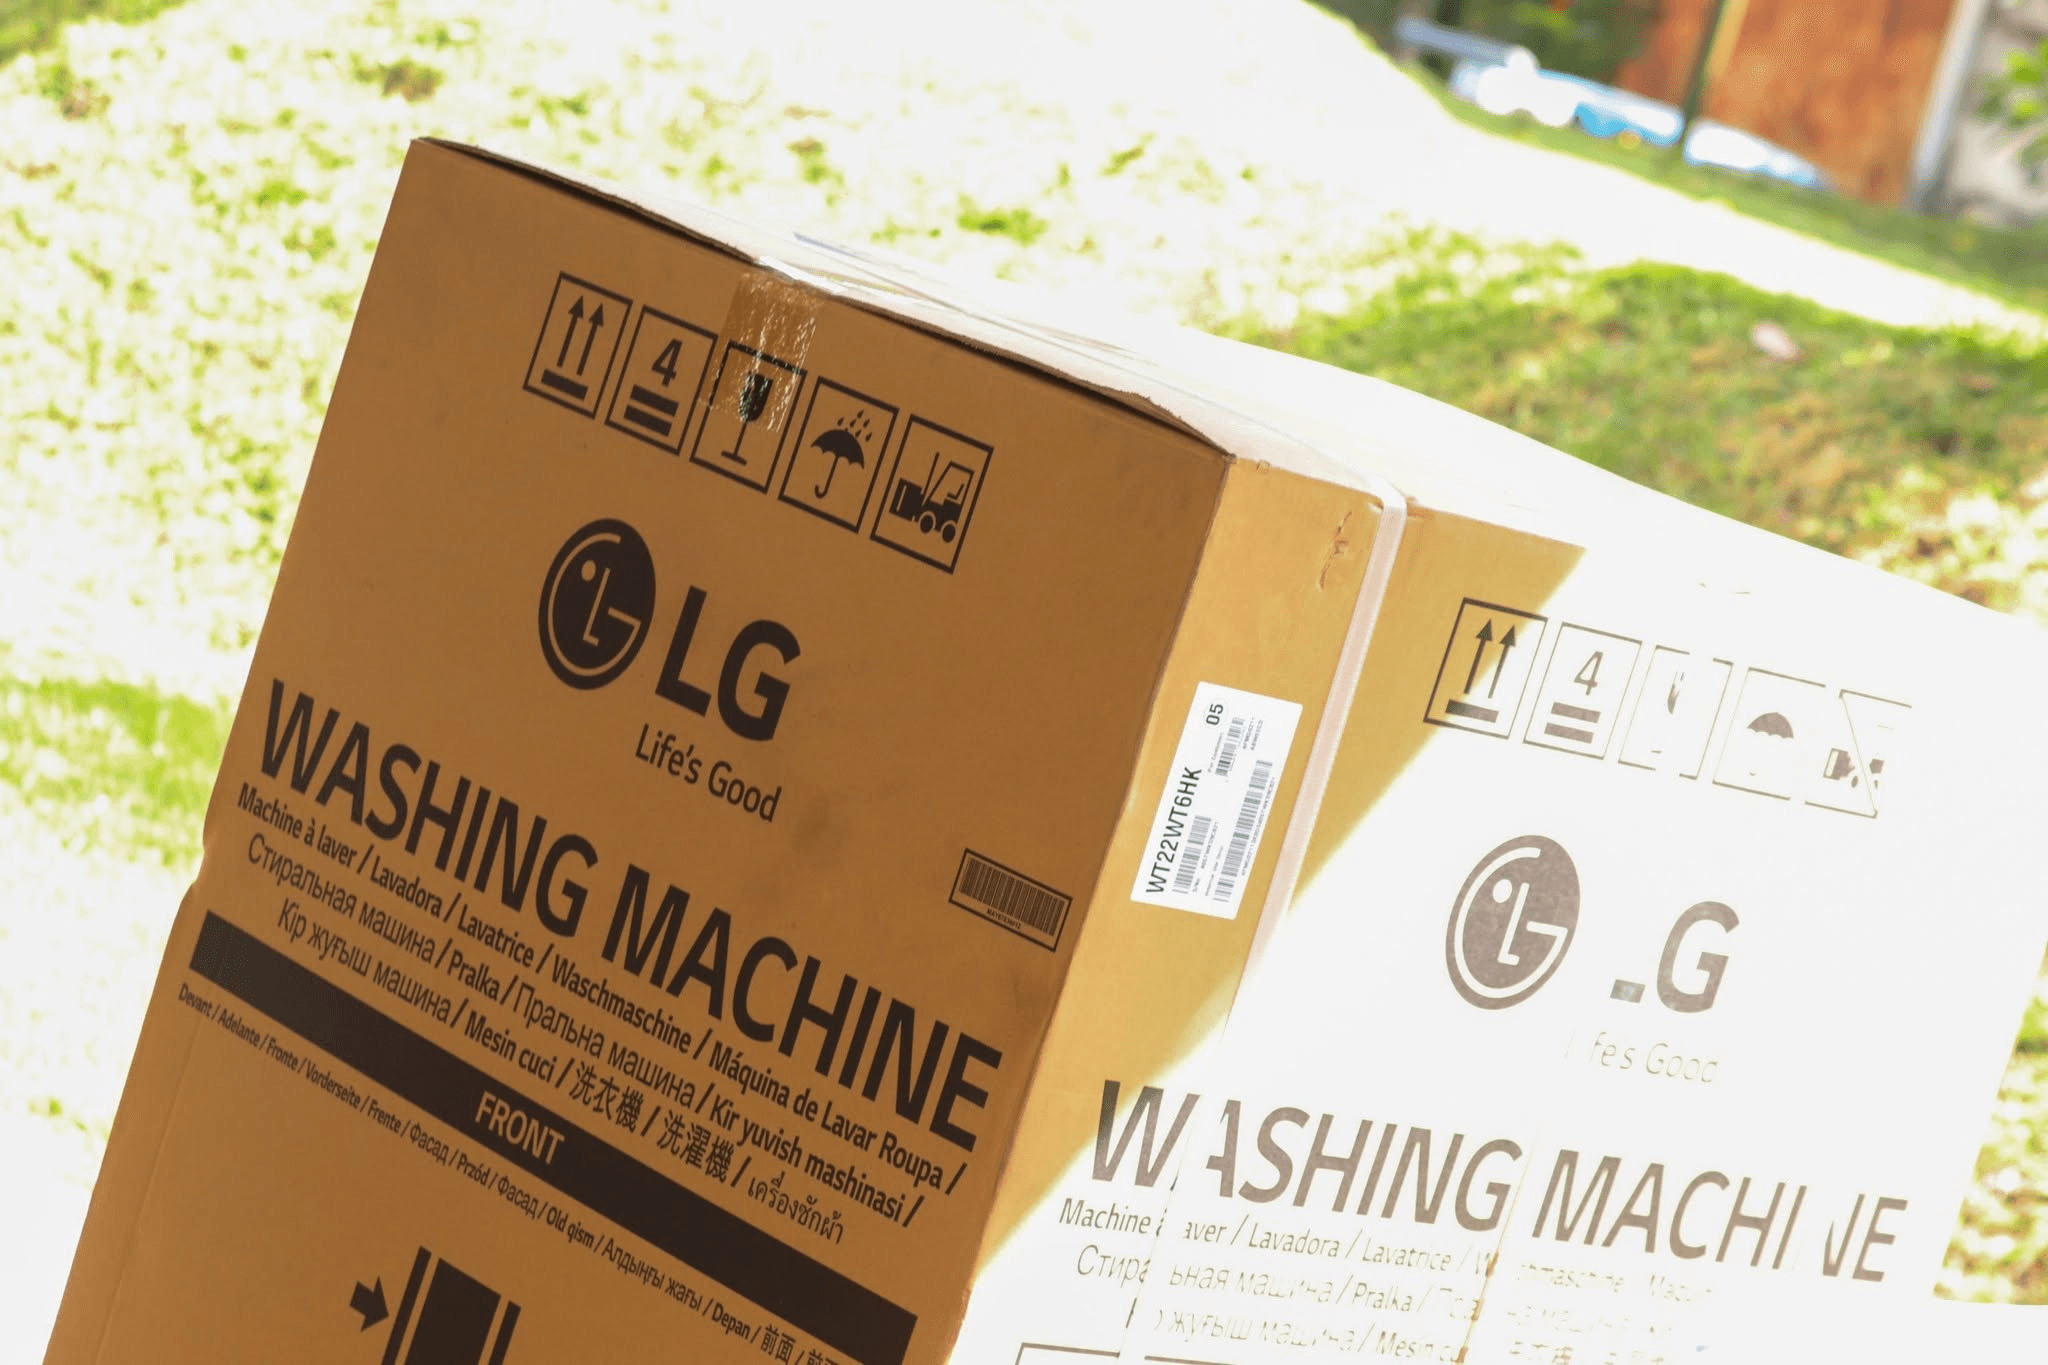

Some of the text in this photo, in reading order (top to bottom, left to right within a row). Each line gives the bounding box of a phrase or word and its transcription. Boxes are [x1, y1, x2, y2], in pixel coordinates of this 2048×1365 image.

[651, 338, 683, 388] 4
[654, 585, 801, 742] LG
[1206, 703, 1225, 726] 05
[1574, 650, 1604, 696] 4
[635, 723, 782, 823] Life's Good
[1145, 766, 1202, 893] WT22WT6HK
[261, 678, 1003, 1153] WASHING MACHINE
[237, 782, 303, 839] Machine
[303, 818, 316, 847] à
[316, 824, 358, 868] laver
[370, 855, 443, 919] Lavadora
[457, 903, 535, 968] Lavatrice
[551, 954, 692, 1054] Waschmaschine
[708, 1040, 790, 1108] Máquina
[792, 1087, 819, 1122] de
[820, 1100, 878, 1152] Lavar
[878, 1131, 944, 1190] Roupa
[248, 833, 358, 919] Стиральная
[358, 901, 436, 964] машина
[447, 949, 500, 1002] Pralka
[513, 982, 605, 1059] Пральна
[607, 1041, 696, 1109] машина
[709, 1094, 740, 1131] Kir
[736, 1117, 803, 1168] yuvish
[803, 1153, 906, 1222] mashinasi
[277, 897, 307, 943] Кір
[306, 922, 373, 977] жуғыш
[372, 961, 452, 1024] машина
[464, 1010, 517, 1062] Mesin
[518, 1049, 558, 1083] cuci
[568, 1061, 644, 1133] 洗衣機
[656, 1109, 734, 1184] 洗濯機
[747, 1171, 844, 1244] เครื่องซักผ้า
[475, 1091, 565, 1164] FRONT
[178, 982, 213, 1018] Devant
[217, 1008, 261, 1048] Adelante
[265, 1037, 299, 1071] Fronte
[305, 1060, 361, 1109] Vorderseite
[367, 1099, 402, 1134] Frente
[409, 1122, 450, 1166] Фасад
[456, 1153, 491, 1186] Przód
[497, 1175, 539, 1220] Фасад
[546, 1206, 569, 1233] Old
[567, 1221, 595, 1249] qism
[601, 1237, 665, 1290] Алдыңғы
[664, 1277, 703, 1312] жағы
[711, 1301, 751, 1340] Depan
[1058, 1197, 1152, 1235] Machine
[1248, 1221, 1341, 1259] Lavadora
